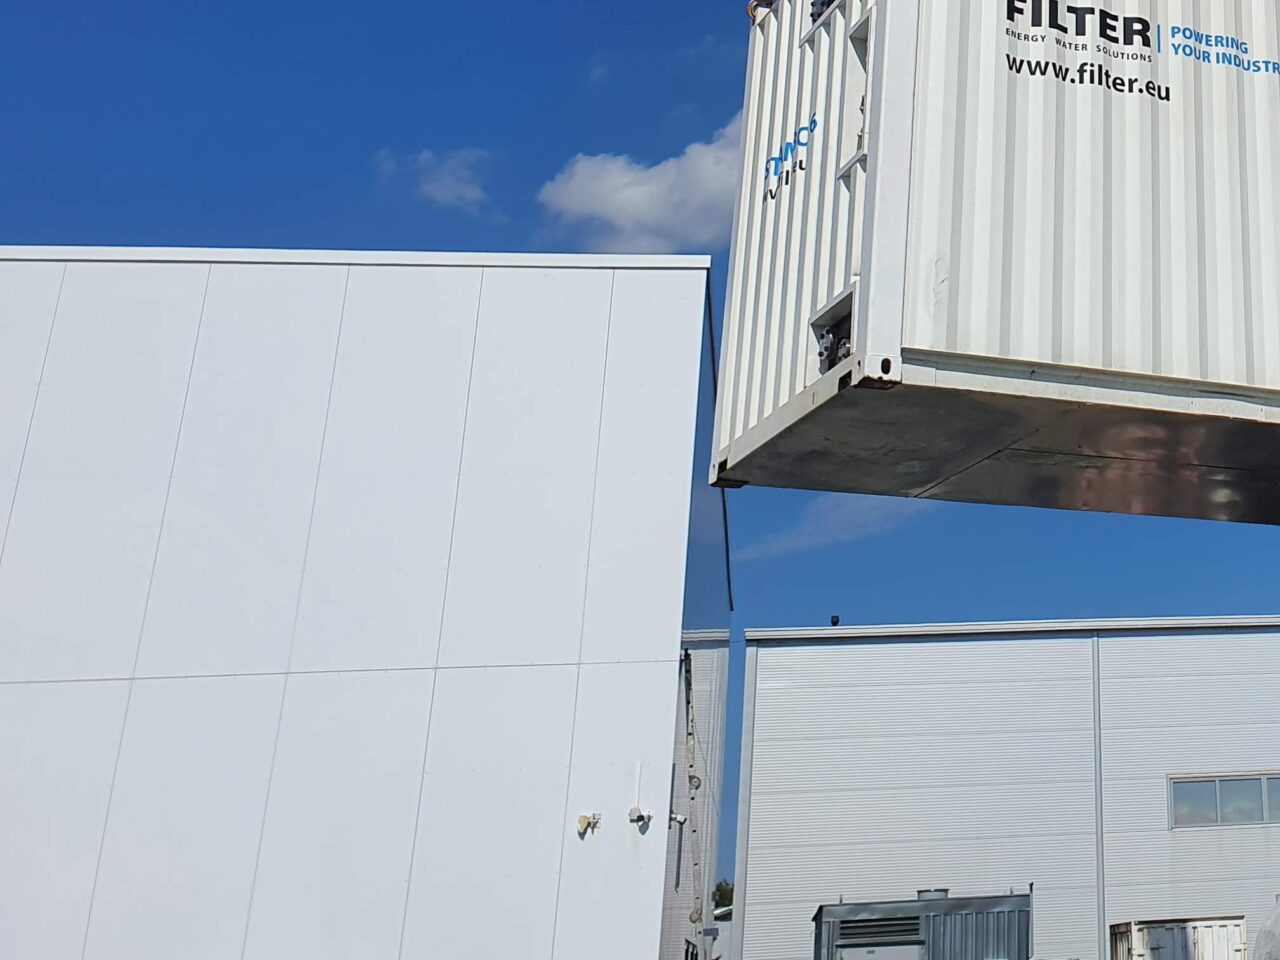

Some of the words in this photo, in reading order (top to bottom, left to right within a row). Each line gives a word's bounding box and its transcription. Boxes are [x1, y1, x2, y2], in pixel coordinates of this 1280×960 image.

[1005, 27, 1047, 43] ENERGY
[1055, 37, 1088, 52] WATER
[1096, 44, 1152, 63] SOLUTIONS
[1171, 26, 1248, 54] POWERING
[1171, 43, 1211, 64] YOUR
[1005, 53, 1171, 102] www.filter.eu
